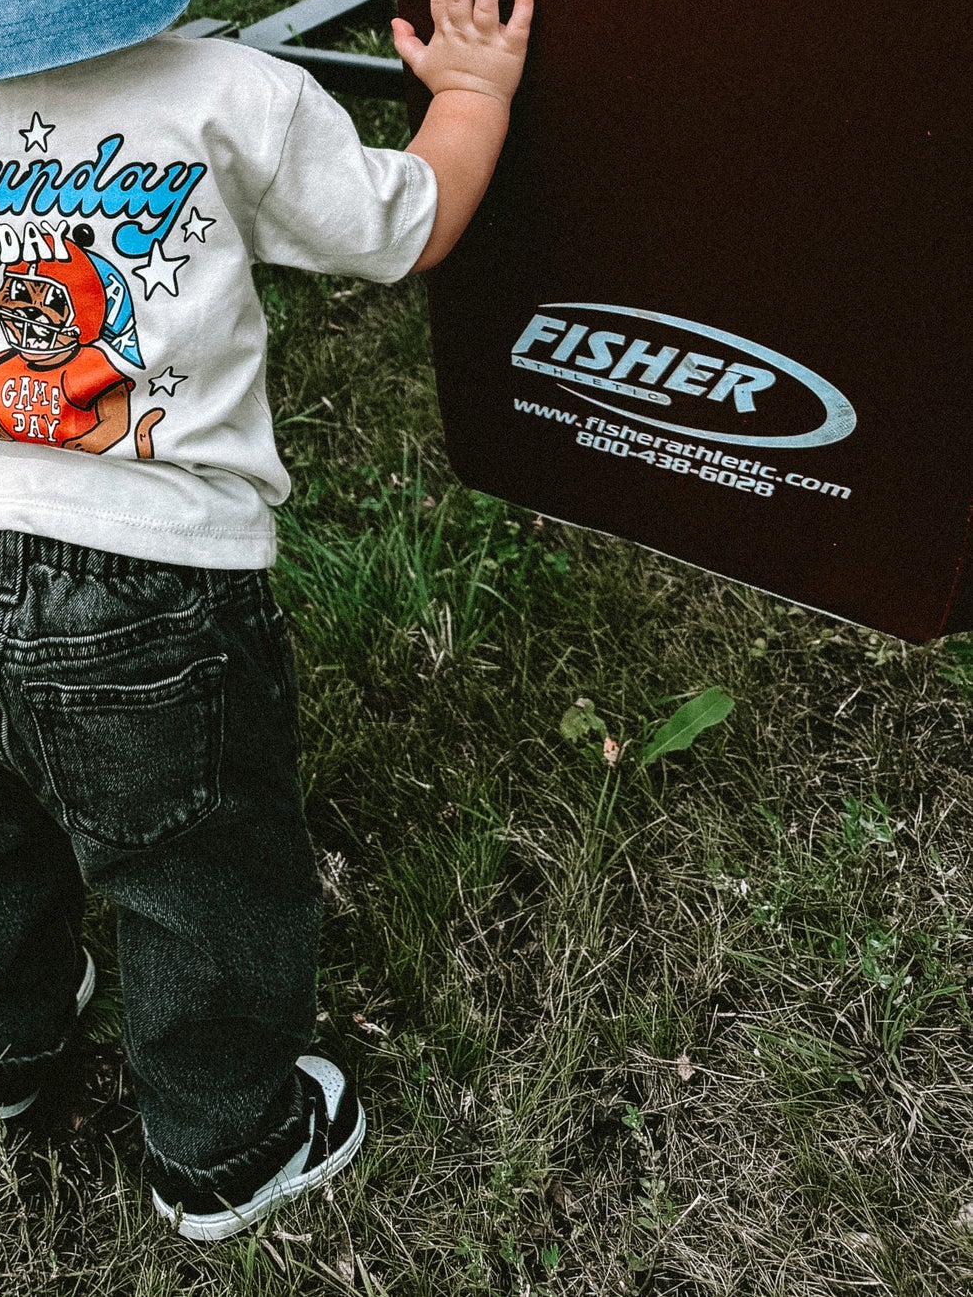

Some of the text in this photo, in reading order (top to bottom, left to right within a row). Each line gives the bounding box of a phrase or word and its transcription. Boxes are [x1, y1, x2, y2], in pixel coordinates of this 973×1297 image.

[511, 314, 776, 413] FISHER
[514, 358, 661, 402] ATHLETIC
[1, 375, 62, 415] GAME
[12, 412, 61, 442] DAY
[513, 397, 853, 500] www.fisherathletic.com
[576, 430, 775, 498] 800-438-6028
